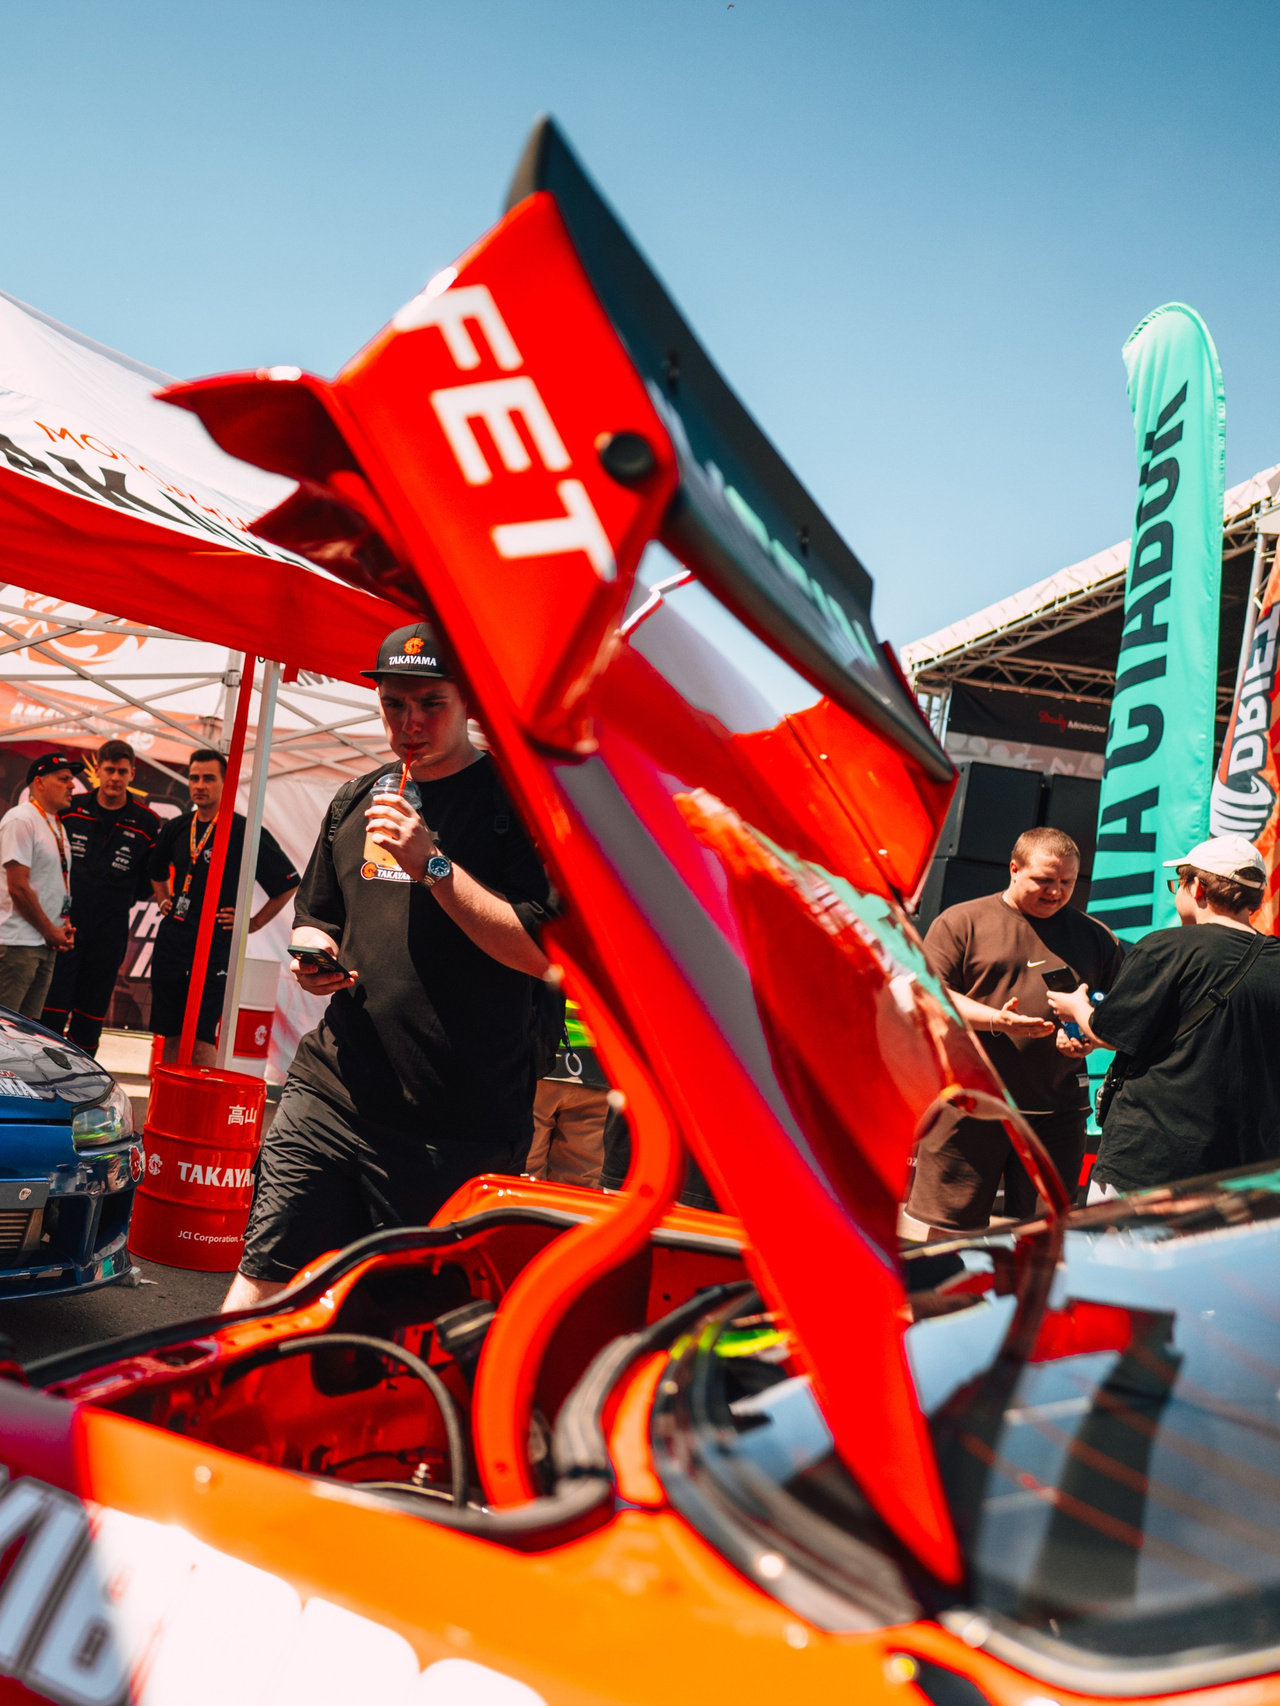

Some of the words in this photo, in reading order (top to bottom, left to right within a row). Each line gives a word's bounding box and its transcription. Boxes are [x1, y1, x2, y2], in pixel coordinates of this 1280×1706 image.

[389, 655, 437, 666] TAKAYAMA
[228, 1105, 257, 1125] 高山
[177, 1161, 253, 1188] TAKAYA
[178, 1230, 192, 1240] JCI
